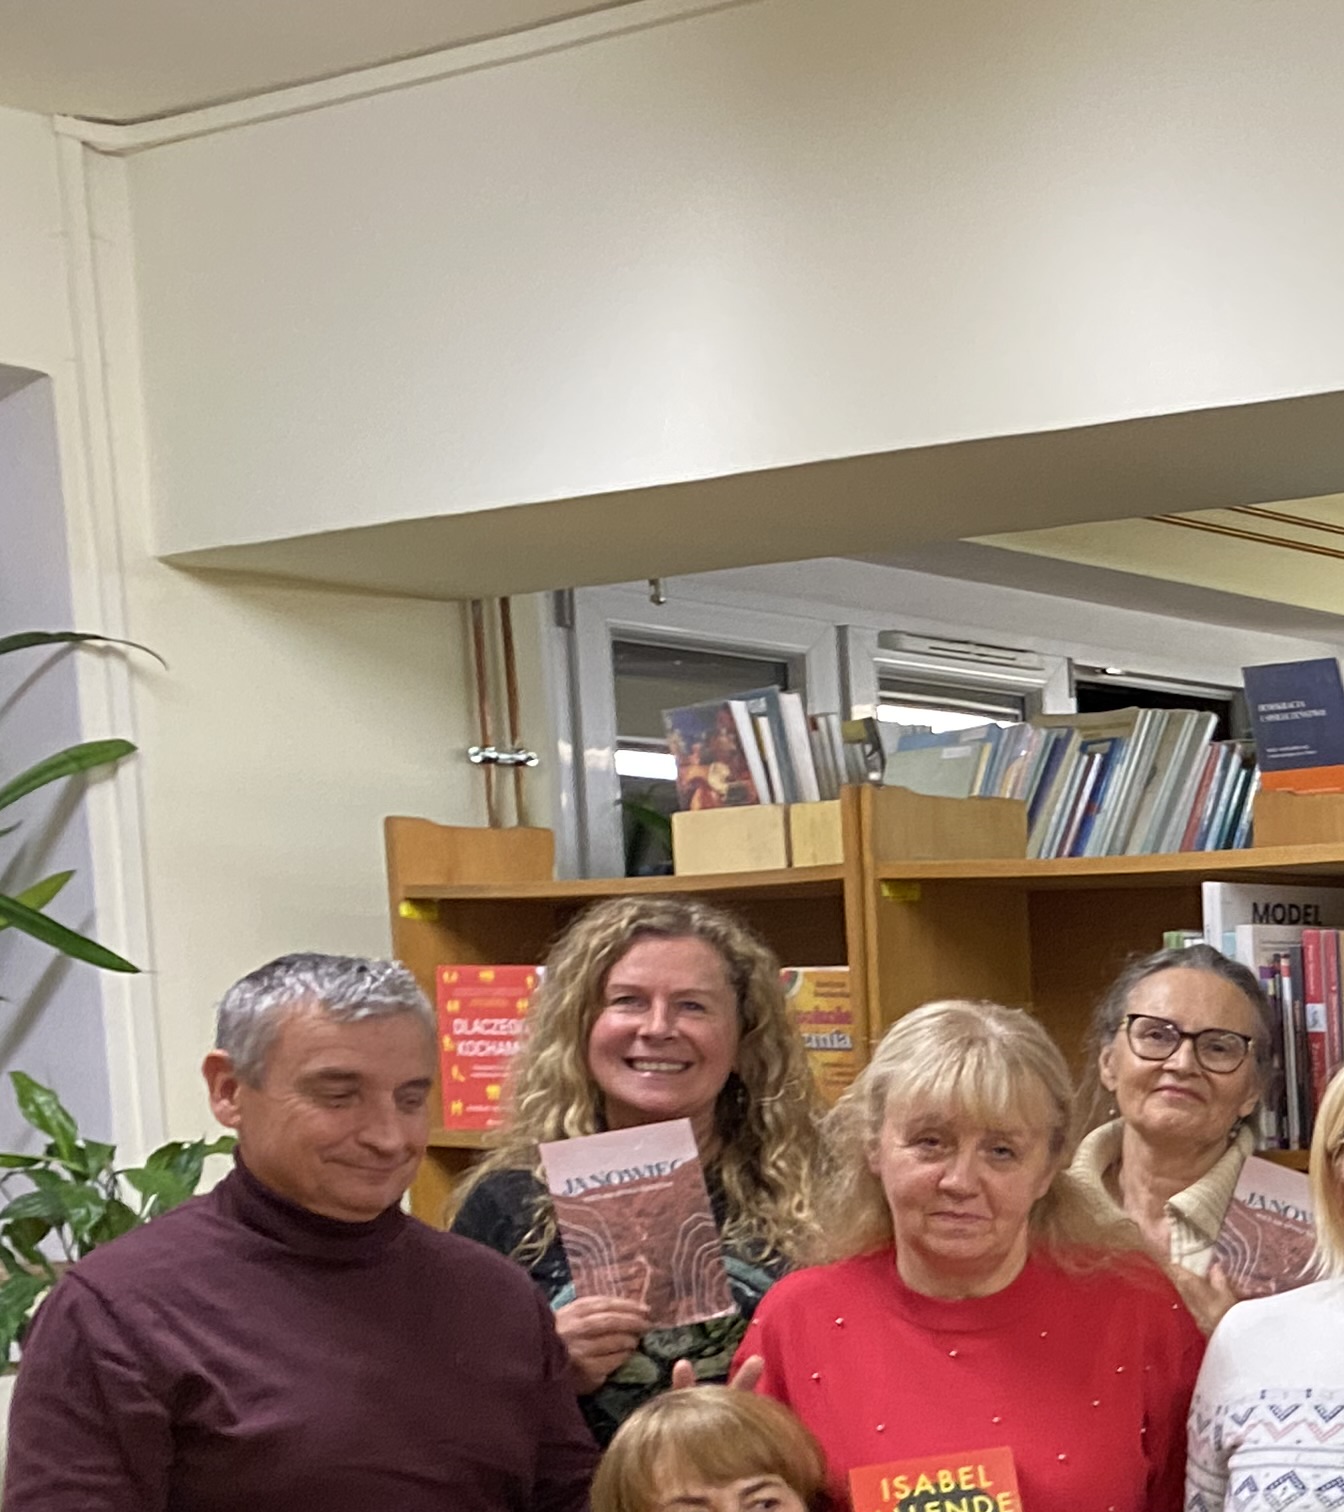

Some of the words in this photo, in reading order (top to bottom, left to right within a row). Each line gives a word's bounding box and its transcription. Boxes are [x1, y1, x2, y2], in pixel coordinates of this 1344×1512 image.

[1252, 902, 1322, 925] MODEL
[452, 1018, 528, 1035] DLACZEG
[562, 1159, 687, 1197] JANOWIEC
[881, 1464, 994, 1502] ISABEL
